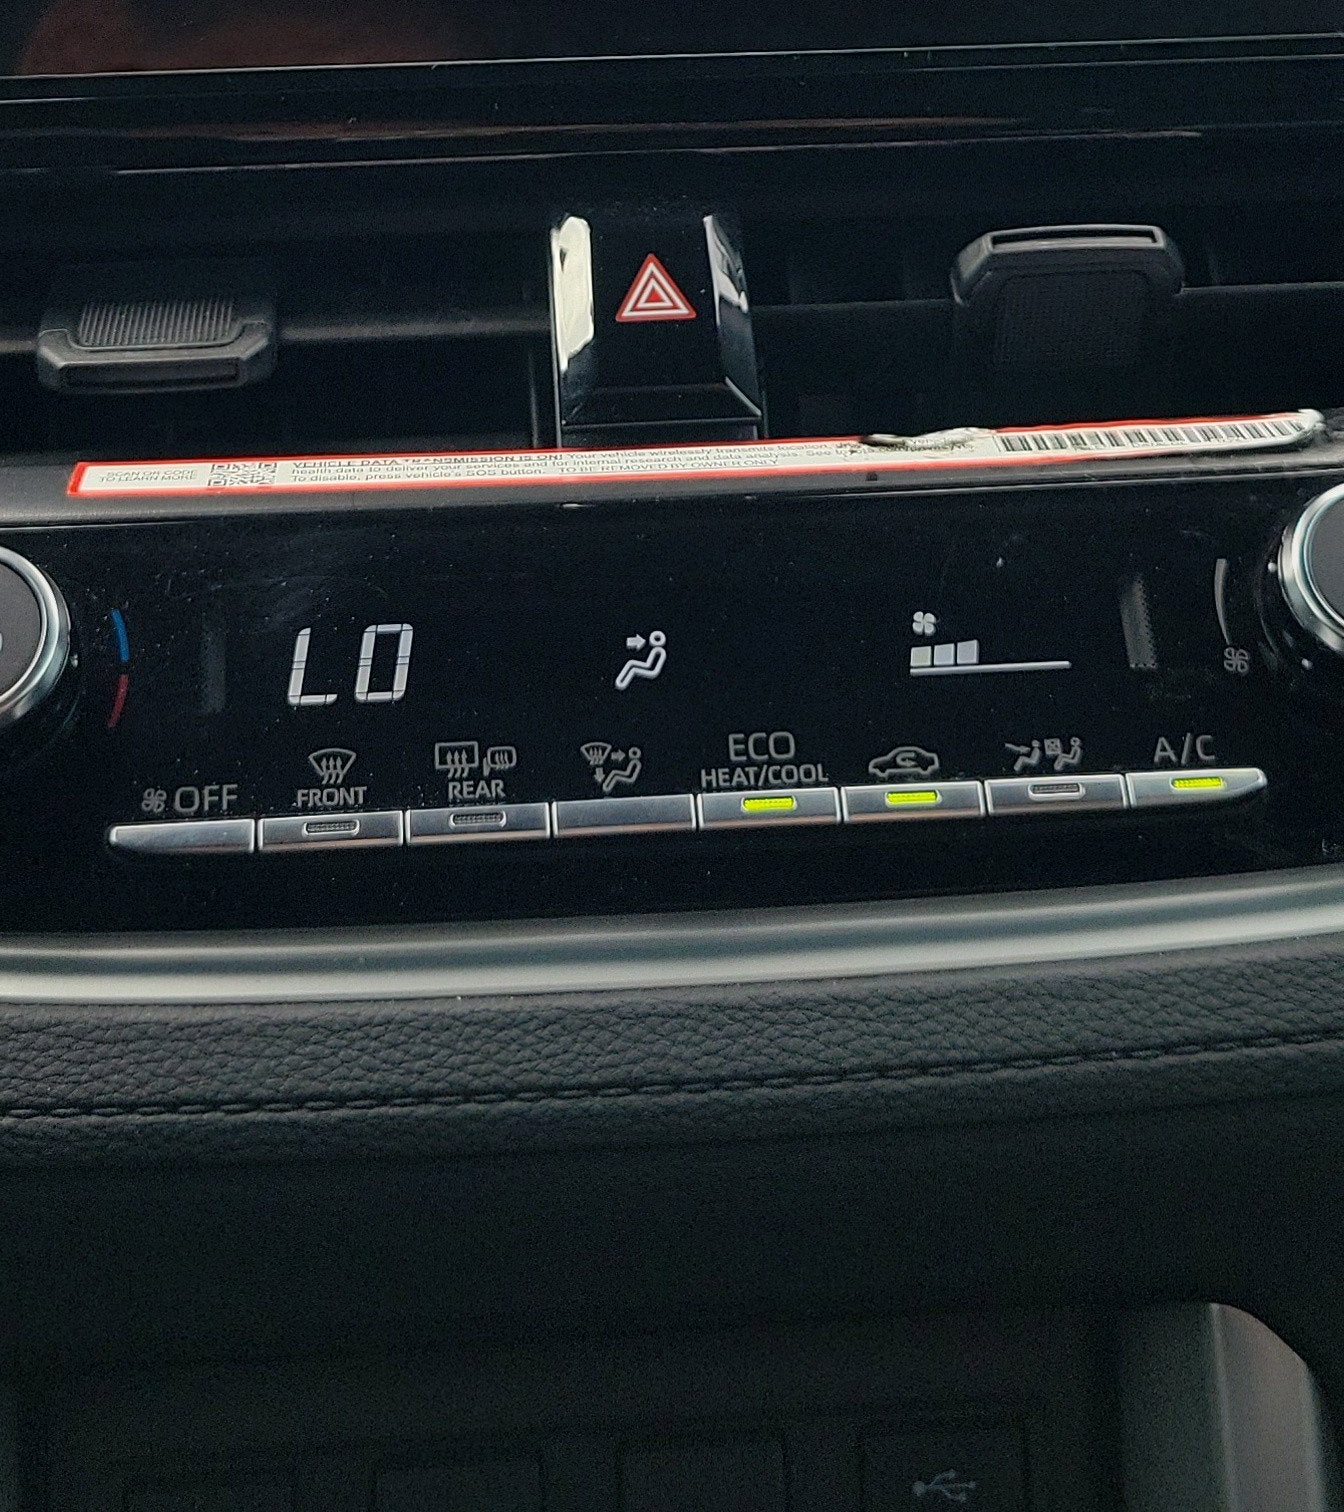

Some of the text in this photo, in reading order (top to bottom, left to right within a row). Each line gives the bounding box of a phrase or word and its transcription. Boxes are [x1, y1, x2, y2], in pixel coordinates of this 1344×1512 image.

[291, 467, 333, 475] health
[385, 464, 429, 473] deliver
[466, 462, 527, 470] services
[573, 457, 622, 466] internal
[625, 455, 683, 464] research
[360, 458, 399, 467] DATA
[649, 448, 712, 456] wirelessly
[715, 446, 774, 454] transmits
[364, 472, 402, 481] press
[406, 471, 462, 479] vehicle's
[287, 622, 414, 707] LO
[727, 731, 796, 764] ECO
[1155, 732, 1218, 764] A/C
[700, 764, 829, 789] HEAT/COOL
[173, 783, 239, 814] OFF
[296, 786, 368, 808] FRONT
[447, 779, 507, 801] REAR
